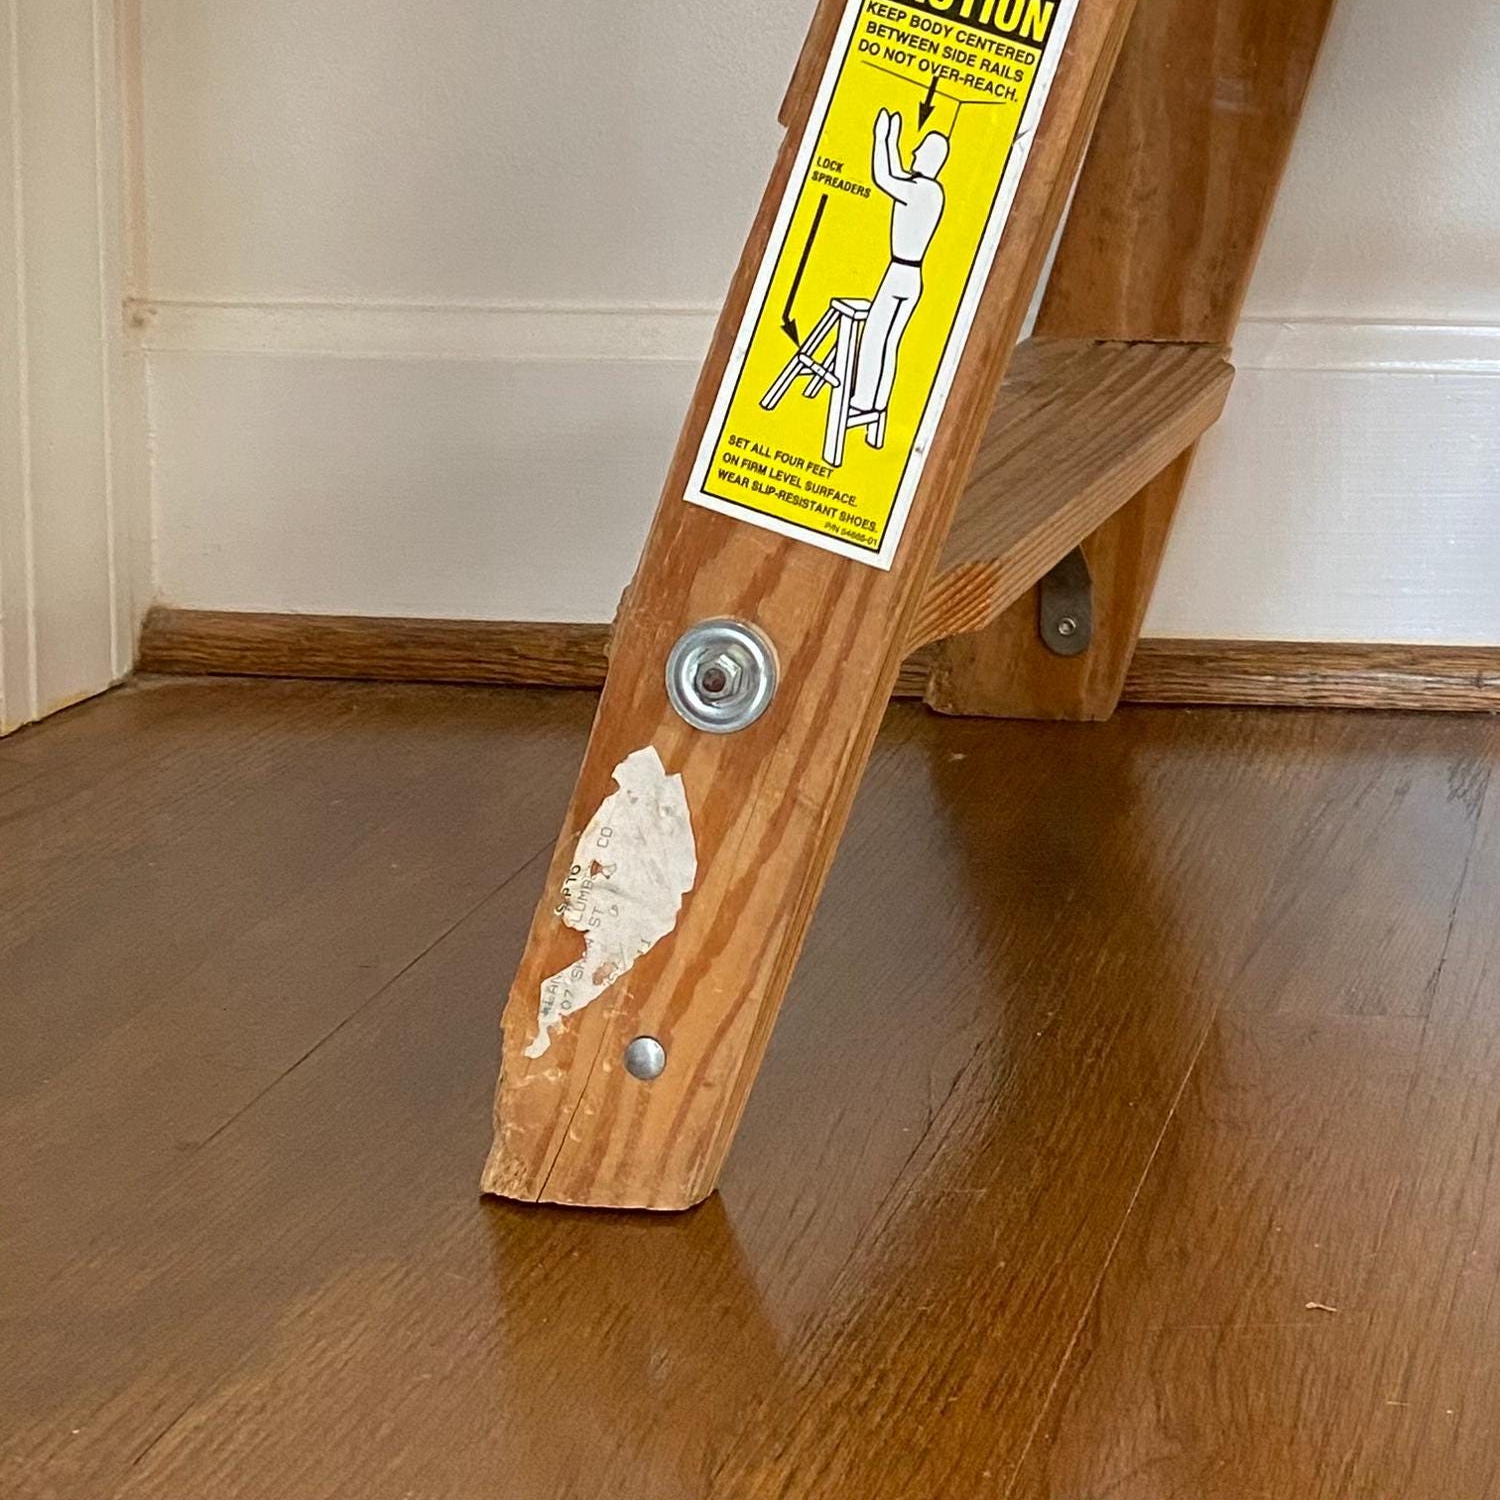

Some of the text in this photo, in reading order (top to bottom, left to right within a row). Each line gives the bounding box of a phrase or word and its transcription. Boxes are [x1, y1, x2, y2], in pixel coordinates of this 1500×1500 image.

[865, 21, 1024, 83] BETWEEN SIDE RAILS
[866, 0, 1035, 65] KEEP BODY CENTERED
[857, 38, 1020, 102] DO NOT OVER-REACH.
[811, 170, 871, 198] SPREADERS
[816, 156, 843, 173] LOCK
[722, 452, 859, 507] ON FIRM LEVEL SURFACE.
[727, 434, 833, 479] SET ALL FOUR FEET
[717, 468, 879, 533] WEAR SLIP-RESISTANT SHOES.
[597, 825, 614, 849] CO
[588, 906, 605, 927] ST
